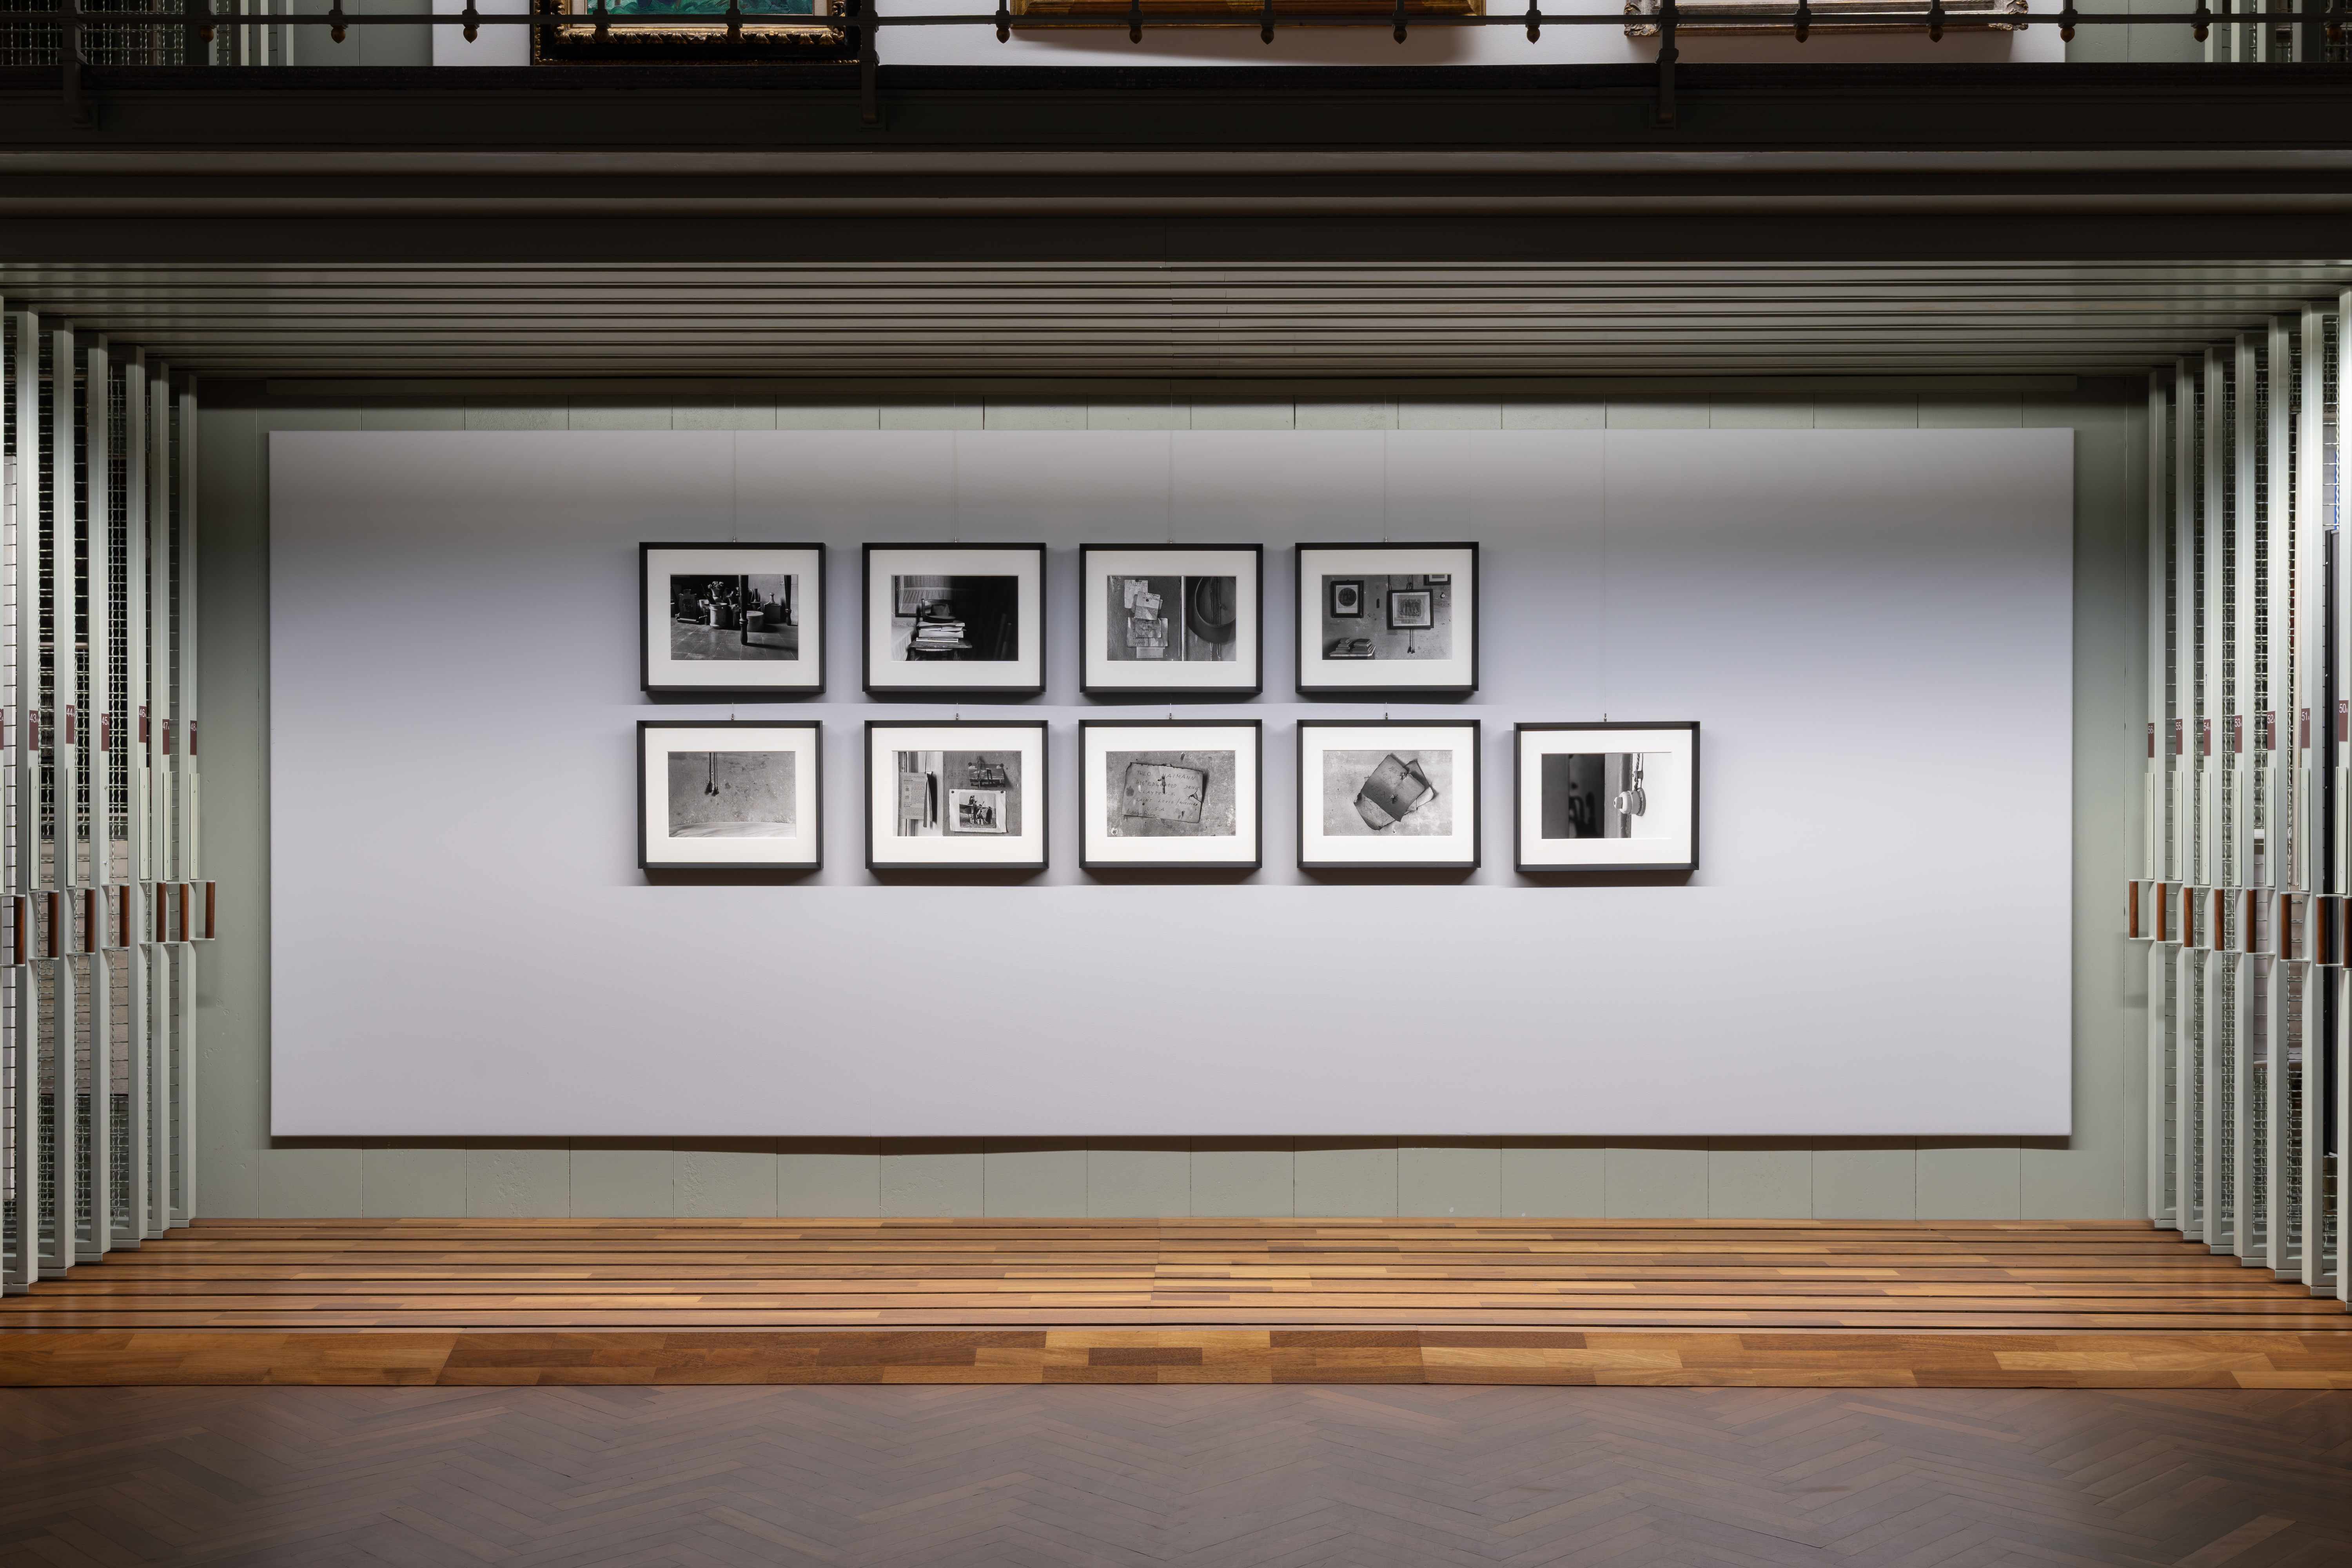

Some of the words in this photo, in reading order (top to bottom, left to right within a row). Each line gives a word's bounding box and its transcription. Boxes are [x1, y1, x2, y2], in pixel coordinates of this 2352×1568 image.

[66, 708, 74, 717] 44A
[2339, 703, 2348, 713] 50A
[29, 713, 38, 723] 43A
[2301, 711, 2310, 721] 51A
